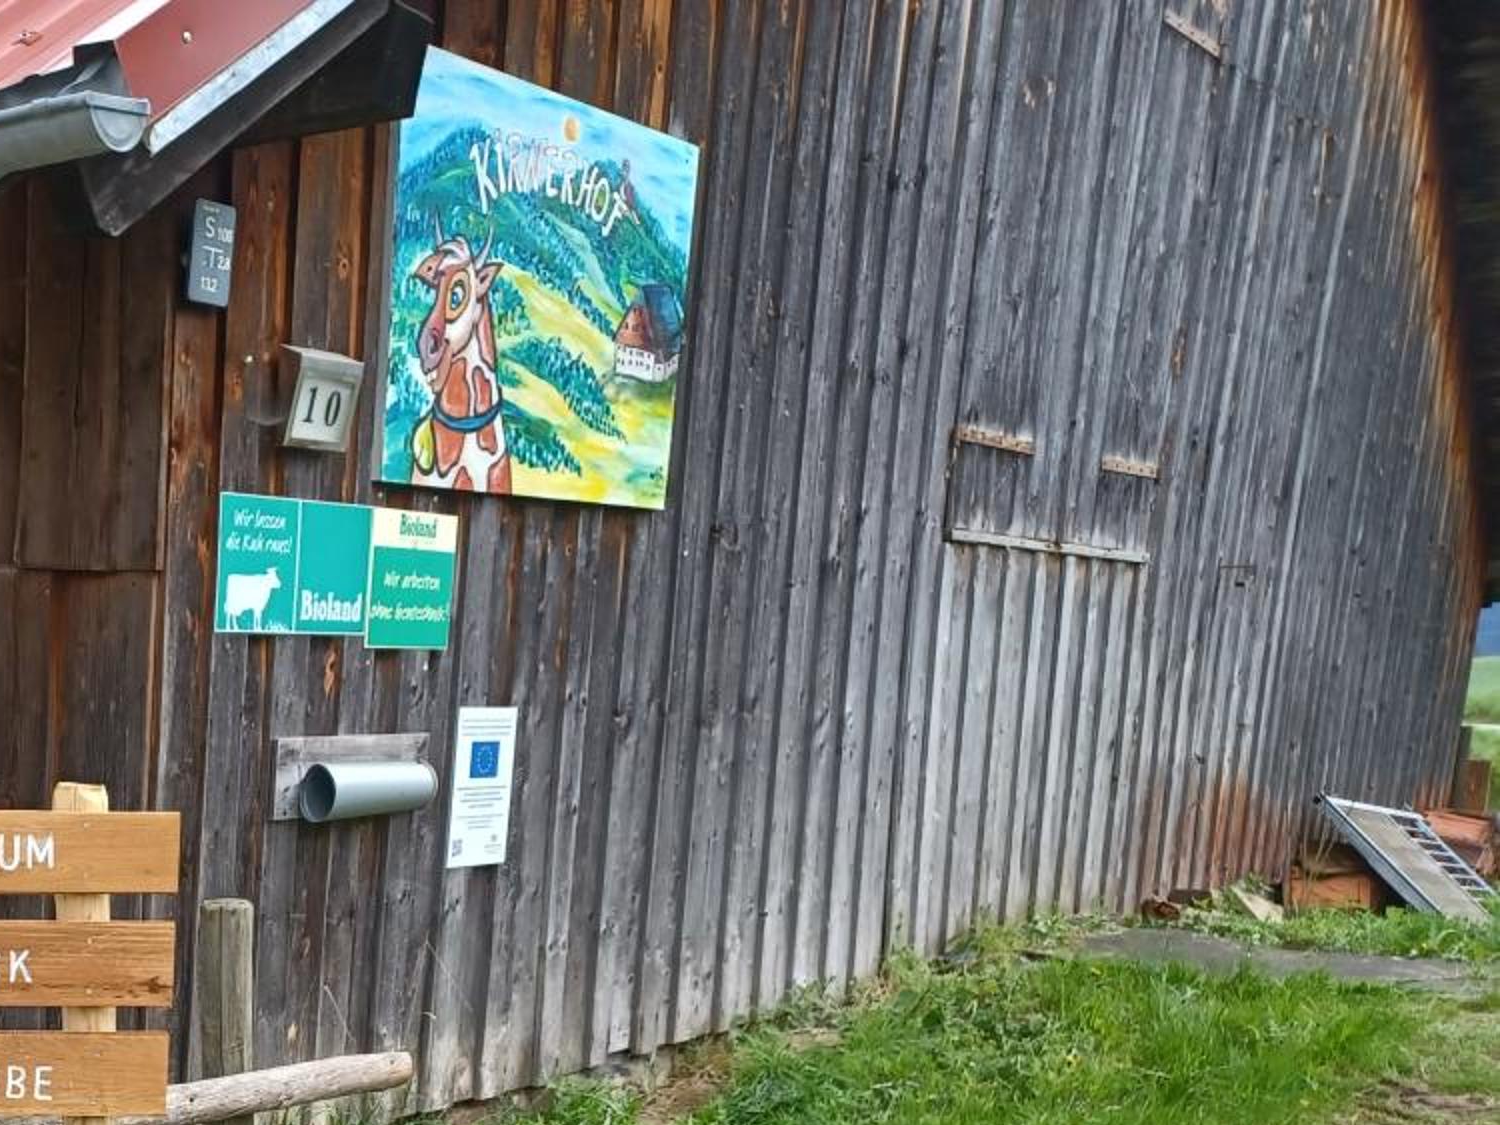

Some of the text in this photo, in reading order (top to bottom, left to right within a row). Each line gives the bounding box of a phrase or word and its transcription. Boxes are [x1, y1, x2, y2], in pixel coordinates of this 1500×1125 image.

[303, 386, 342, 427] 10
[399, 513, 438, 539] Bioland
[301, 588, 363, 623] Bioland
